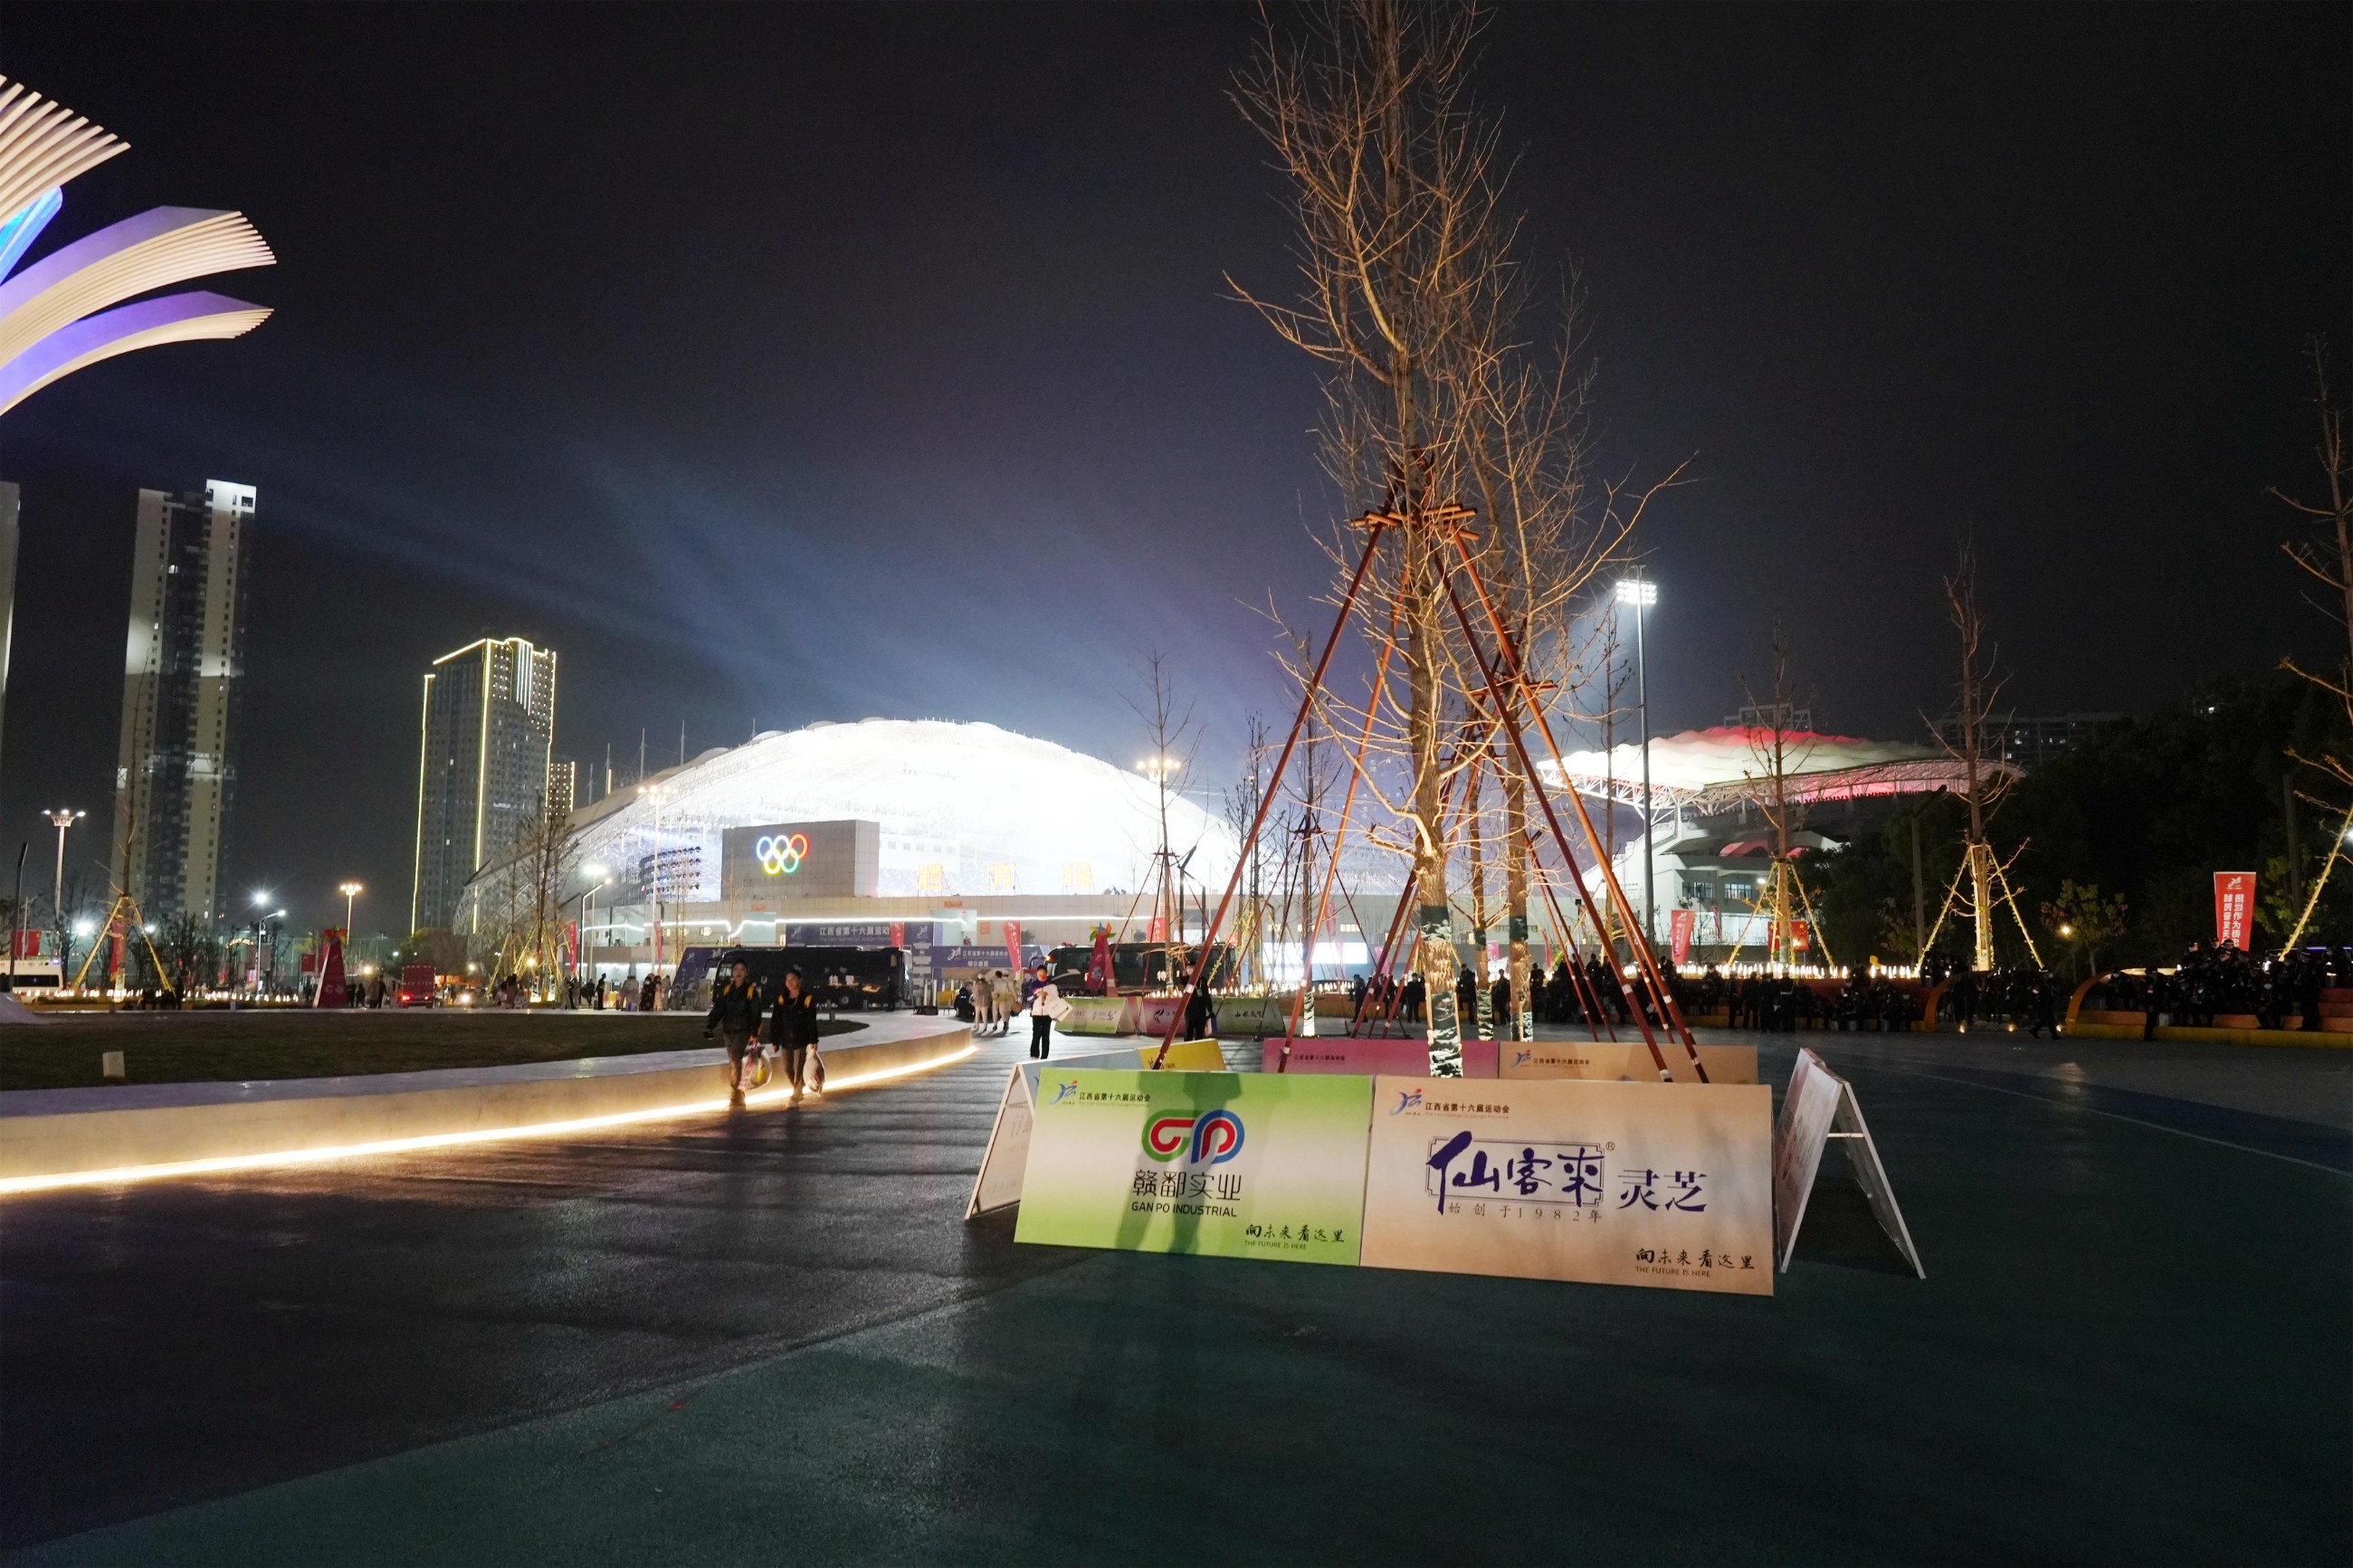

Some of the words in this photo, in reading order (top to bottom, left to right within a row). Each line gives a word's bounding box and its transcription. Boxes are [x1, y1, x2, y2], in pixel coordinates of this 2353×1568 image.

[818, 926, 891, 936] 江西省第十六届运动
[1079, 1091, 1151, 1102] 江西省第十六届运动会
[1424, 1101, 1510, 1114] 江西省第十六届运动会
[1132, 1169, 1242, 1201] 赣鄱实业
[1616, 1168, 1708, 1212] 灵芝
[1131, 1202, 1154, 1212] GAN
[1156, 1202, 1170, 1213] PO
[1173, 1203, 1237, 1217] INDUSTRIAL
[1258, 1240, 1281, 1249] FUTURE
[1652, 1267, 1680, 1276] FUTURE
[1691, 1269, 1710, 1278] HERE
